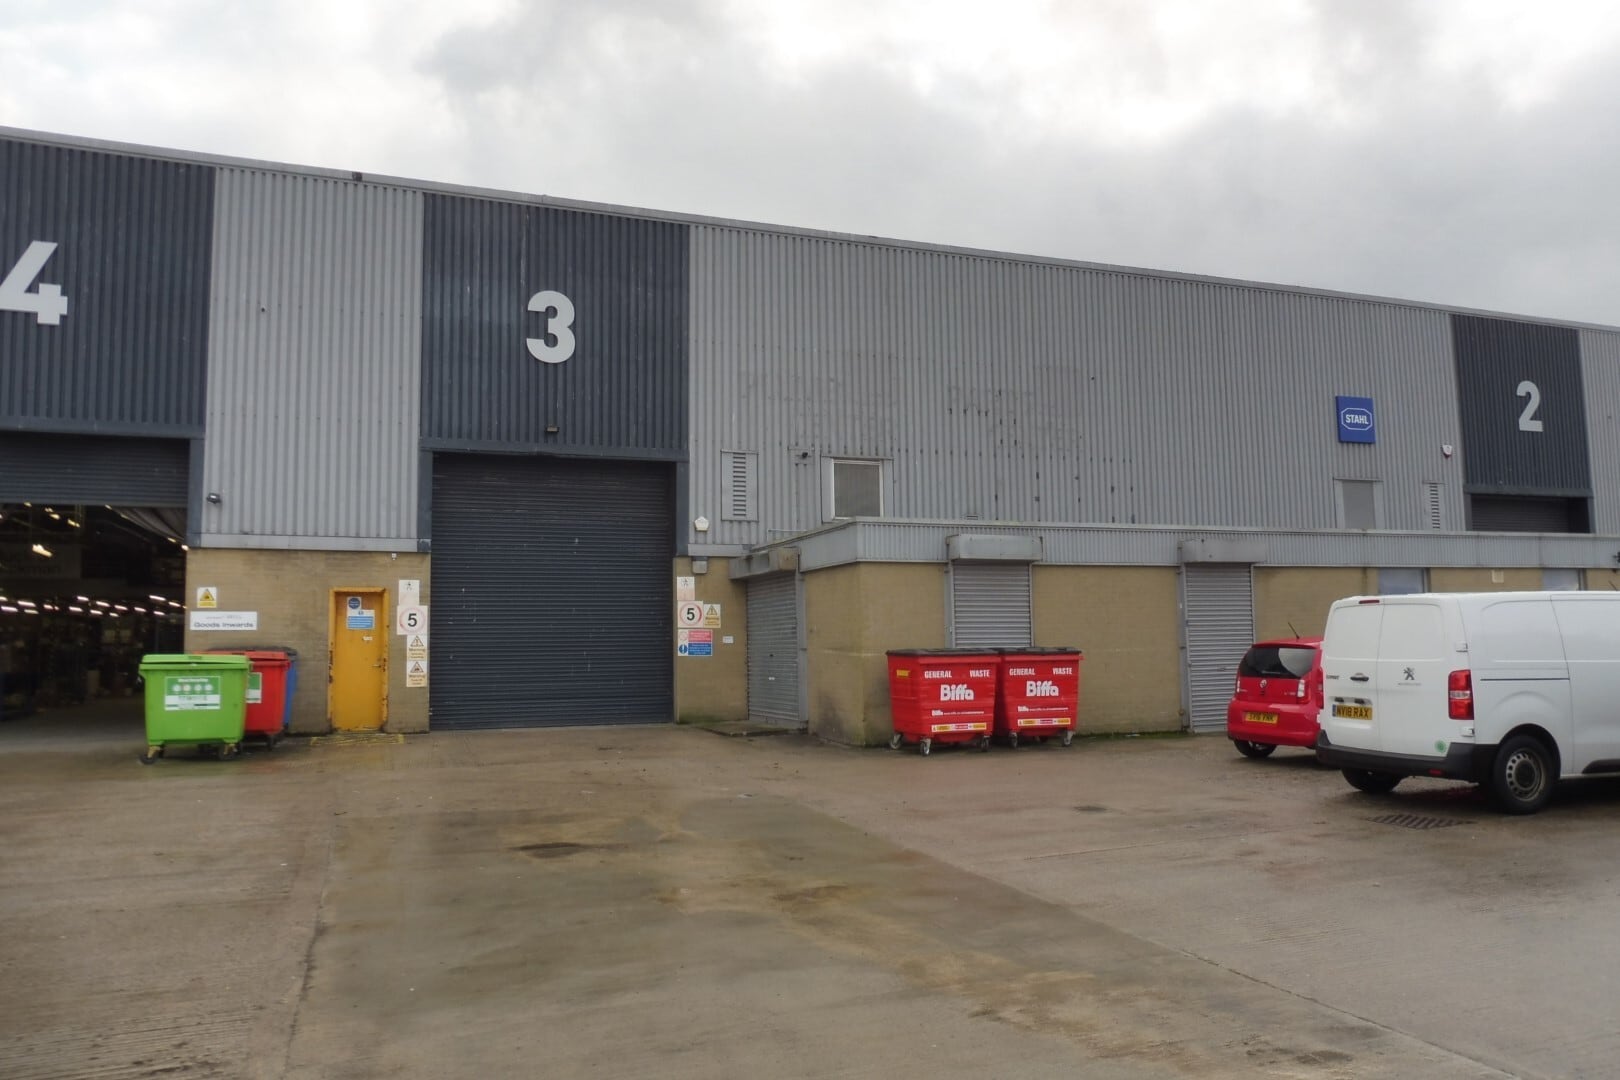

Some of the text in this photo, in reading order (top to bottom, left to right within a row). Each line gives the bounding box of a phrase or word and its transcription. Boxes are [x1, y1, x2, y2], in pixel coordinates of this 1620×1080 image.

[0, 240, 68, 326] 4
[526, 290, 576, 364] 3
[1516, 380, 1543, 432] 2
[1345, 414, 1369, 425] STAHL
[408, 613, 417, 627] 5
[686, 608, 695, 621] 5
[924, 669, 990, 679] GENERAL WASTE
[1009, 667, 1072, 676] GENERAL WASTE
[940, 683, 974, 701] Biffa
[1026, 680, 1059, 697] Biffa
[1353, 706, 1369, 719] RAX
